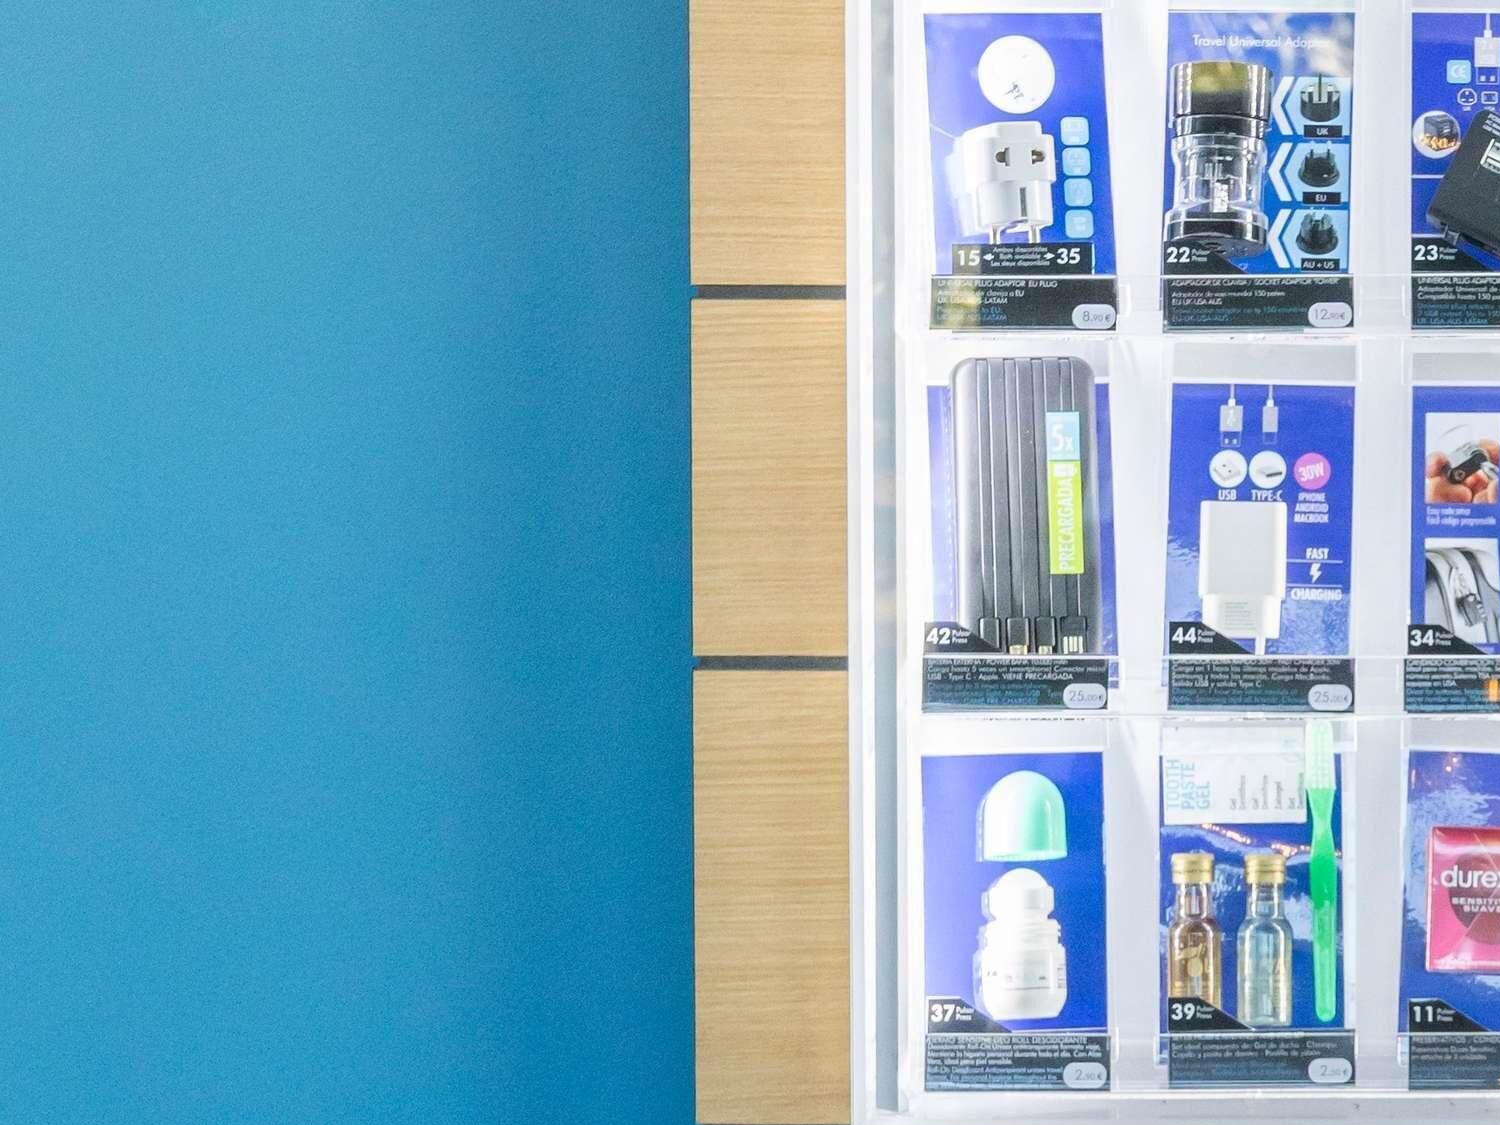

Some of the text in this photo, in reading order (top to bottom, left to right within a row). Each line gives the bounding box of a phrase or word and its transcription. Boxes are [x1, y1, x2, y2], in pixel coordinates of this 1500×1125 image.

[1193, 35, 1225, 47] Travel
[1316, 127, 1328, 135] UK
[1315, 194, 1327, 202] EU
[957, 250, 980, 266] 15
[1057, 248, 1081, 264] 35
[1166, 247, 1190, 263] 22
[1414, 245, 1438, 261] 23
[1298, 462, 1325, 482] 30W
[1218, 489, 1237, 500] USB
[1251, 489, 1282, 501] TYPE-C
[1306, 548, 1329, 559] FAST
[1291, 589, 1343, 601] CHARGING
[926, 627, 950, 645] 42
[1171, 627, 1197, 644] 44
[1410, 630, 1434, 646] 34
[1166, 759, 1180, 809] TOOTH
[1181, 761, 1196, 809] PASTE
[1196, 781, 1211, 809] GEL
[930, 1004, 955, 1023] 37
[1171, 1003, 1195, 1020] 39
[1413, 1006, 1432, 1022] 11
